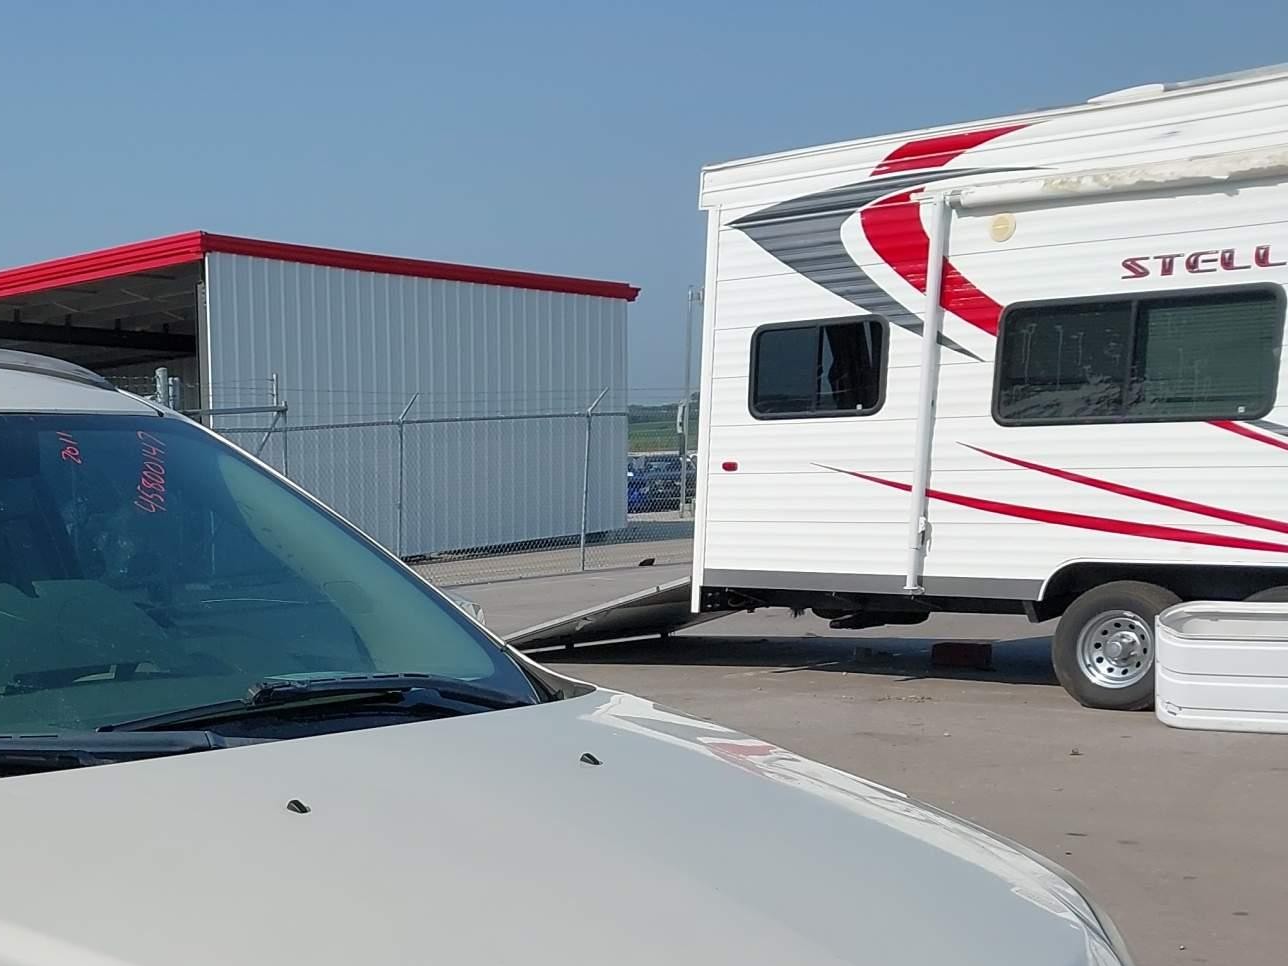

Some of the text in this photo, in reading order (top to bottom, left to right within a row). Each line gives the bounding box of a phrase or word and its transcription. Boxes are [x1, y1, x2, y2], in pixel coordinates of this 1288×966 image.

[1121, 244, 1287, 280] STELL
[56, 431, 82, 464] 2011
[134, 430, 167, 513] 45800147
